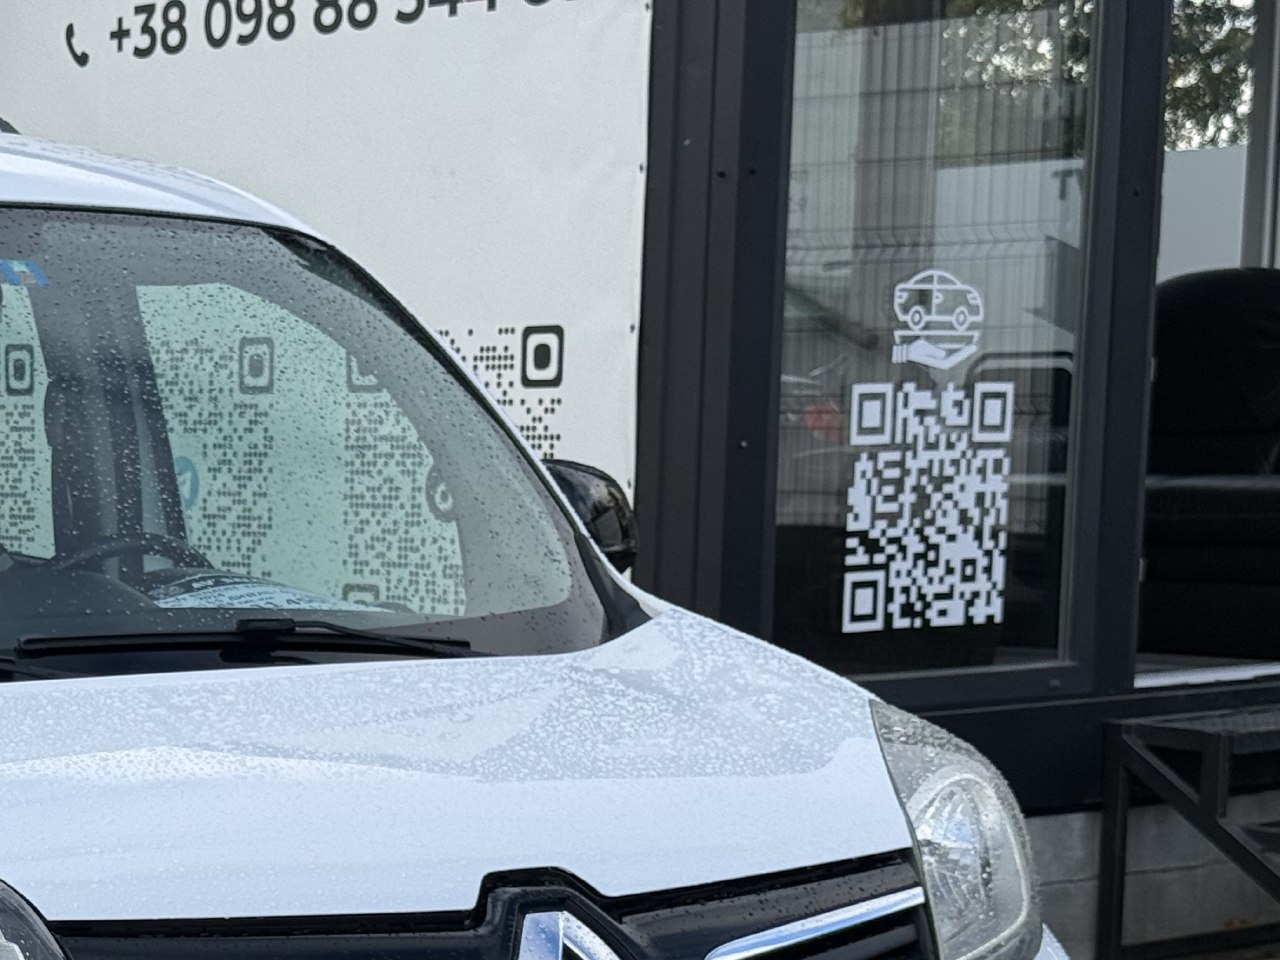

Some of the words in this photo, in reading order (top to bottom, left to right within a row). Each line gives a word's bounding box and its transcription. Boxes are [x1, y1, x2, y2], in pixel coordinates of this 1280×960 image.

[109, 0, 187, 59] +38
[205, 0, 295, 49] 098
[314, 0, 378, 35] 88
